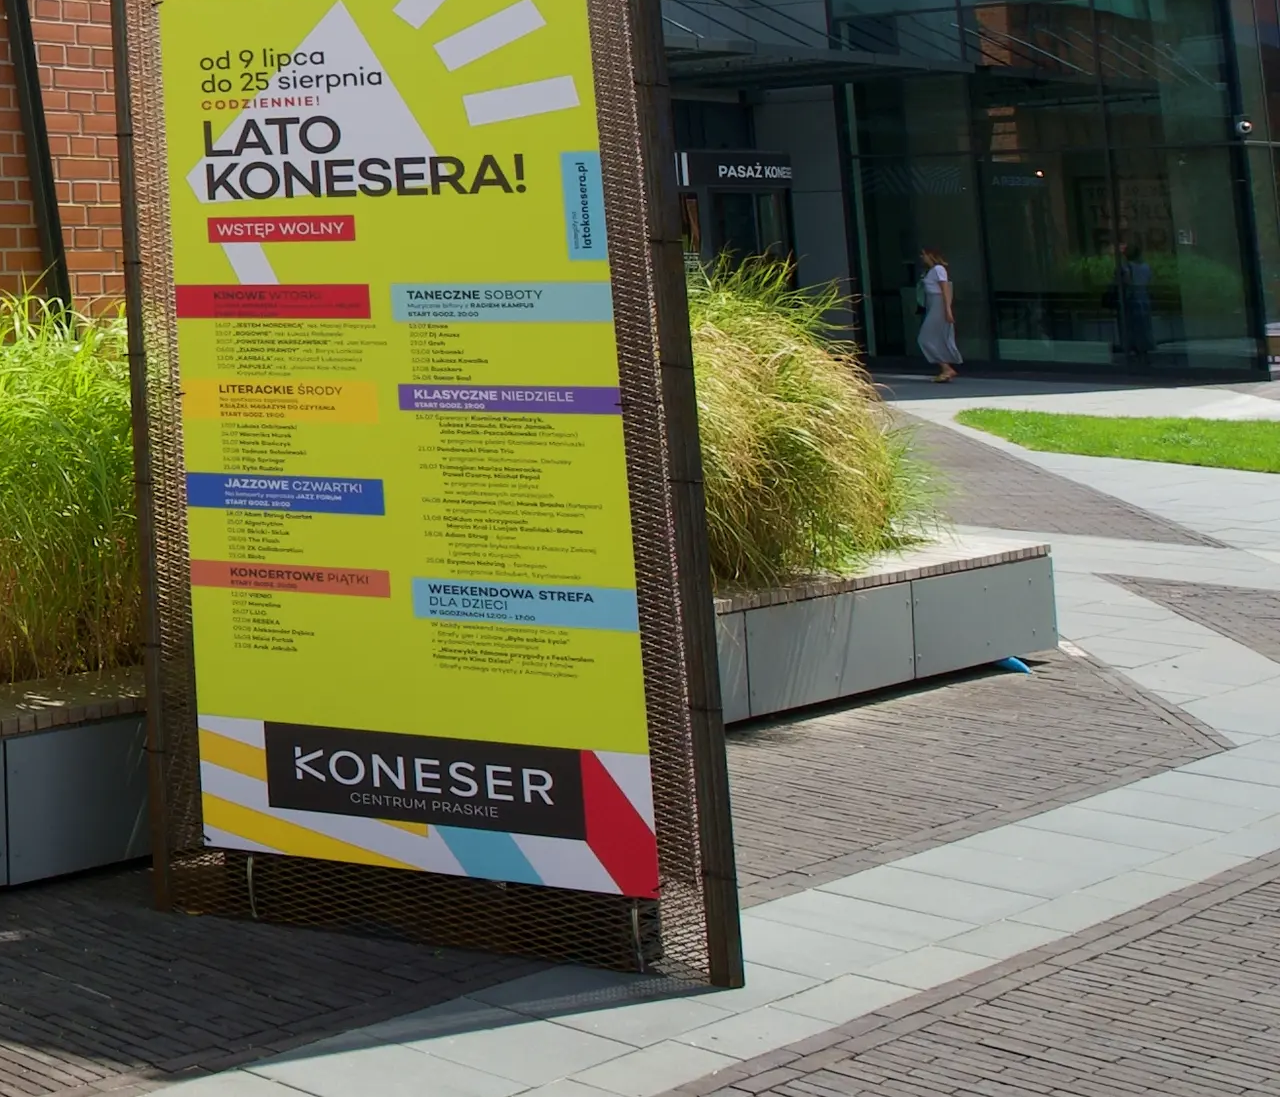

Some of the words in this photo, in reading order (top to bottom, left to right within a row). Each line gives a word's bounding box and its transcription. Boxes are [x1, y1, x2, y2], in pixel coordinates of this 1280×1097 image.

[200, 51, 231, 71] od
[239, 50, 254, 68] 9
[262, 48, 325, 72] lipca
[201, 73, 232, 93] do
[241, 72, 269, 91] 25
[277, 69, 382, 92] sierpnia
[201, 96, 320, 110] CODZIENNIE!
[204, 116, 341, 157] LATO
[206, 154, 527, 200] KONESERA!
[718, 162, 762, 178] PASAŻ
[574, 162, 592, 249] latokonesera.pl
[217, 222, 275, 238] WSTĘP
[279, 220, 344, 236] WOLNY
[214, 291, 266, 300] KINOWE
[407, 290, 480, 300] TANECZNE
[484, 290, 543, 300] SOBOTY
[219, 384, 294, 395] LITERACKIE
[298, 383, 343, 395] ŚRODY
[414, 389, 498, 401] KLASYCZNE
[501, 391, 574, 402] NIEDZIELE
[225, 478, 289, 490] JAZZOWE
[293, 480, 362, 493] CZWARTKI
[230, 567, 324, 582] KONCERTOWE
[327, 573, 369, 586] PIĄTKI
[428, 584, 535, 600] WEEKENDOWA
[538, 590, 594, 603] STREFA
[429, 596, 458, 607] DLA
[462, 598, 508, 610] DZIECI
[294, 745, 556, 806] KONESER
[350, 792, 427, 811] CENTRUM
[431, 800, 499, 819] PRASKIE
